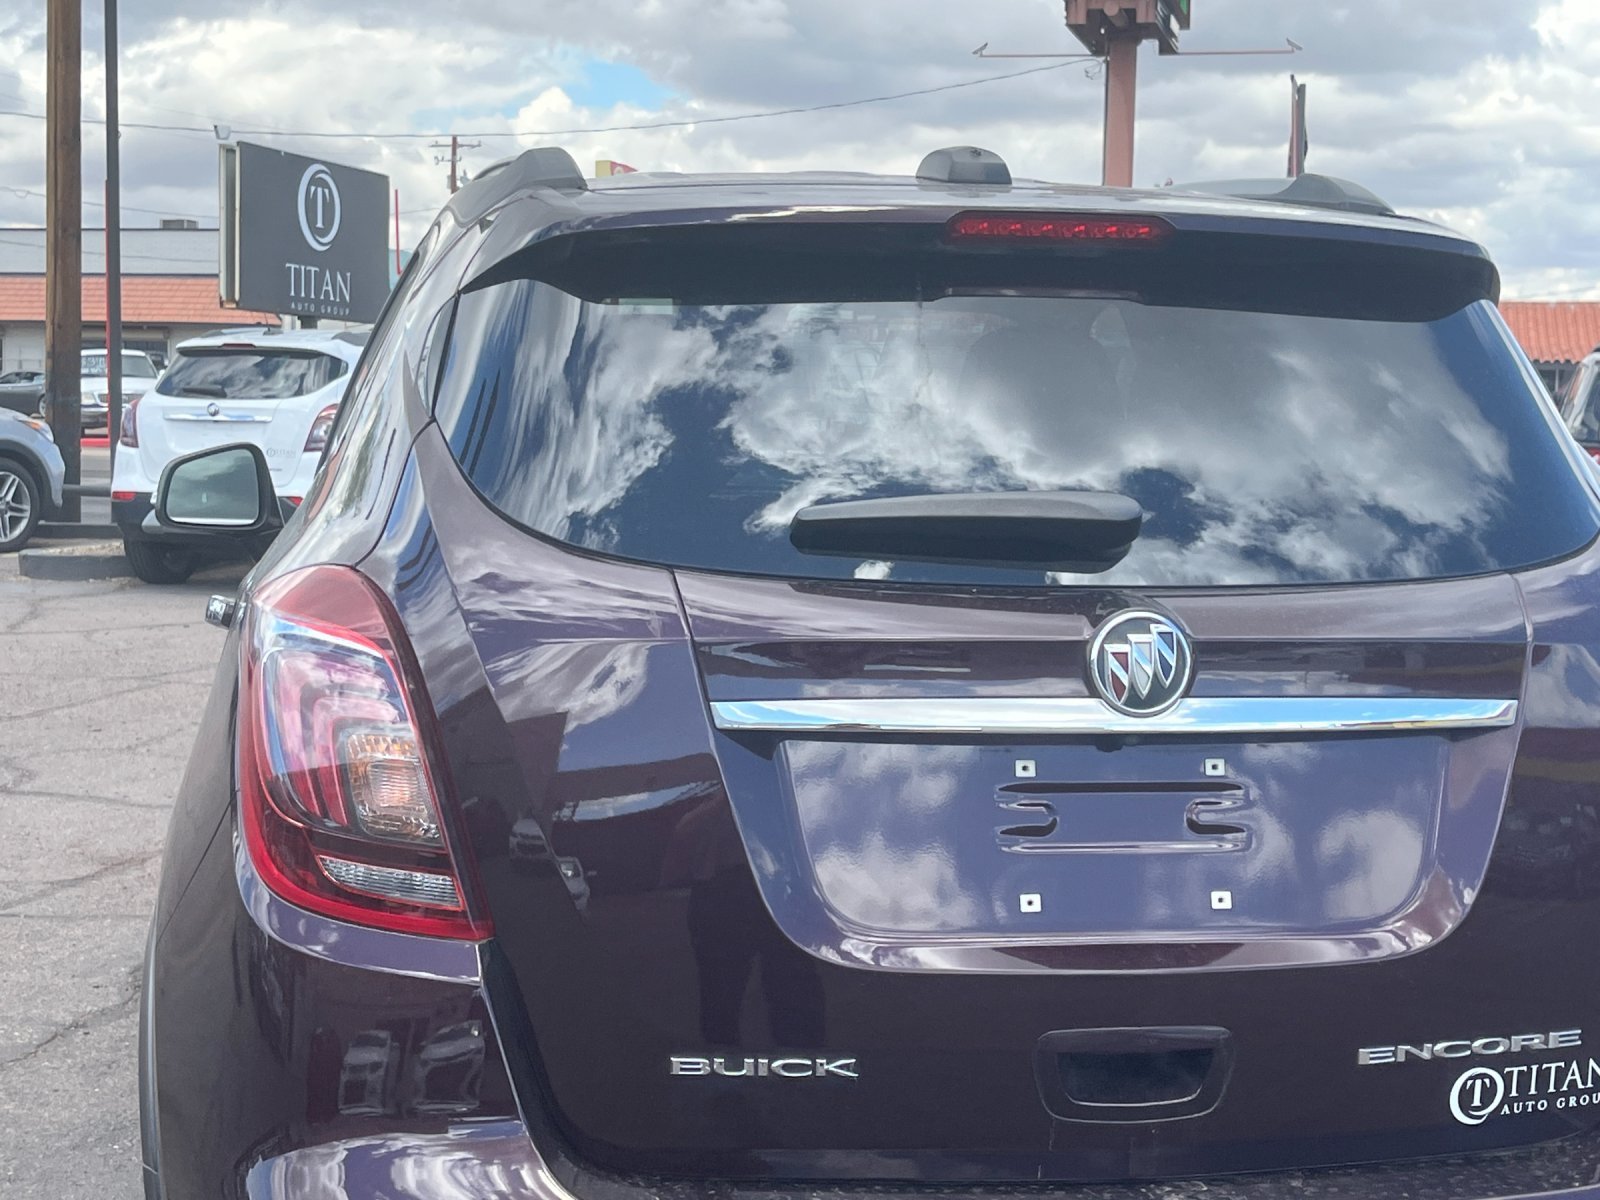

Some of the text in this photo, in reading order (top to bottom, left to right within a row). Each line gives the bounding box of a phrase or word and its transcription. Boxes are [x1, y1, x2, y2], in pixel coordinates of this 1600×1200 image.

[285, 262, 351, 303] TITAN
[291, 301, 350, 316] AUTO GROUP
[1358, 1029, 1582, 1065] ENCORE
[670, 1057, 859, 1077] BUICK
[1500, 1091, 1600, 1115] AUTO GROU
